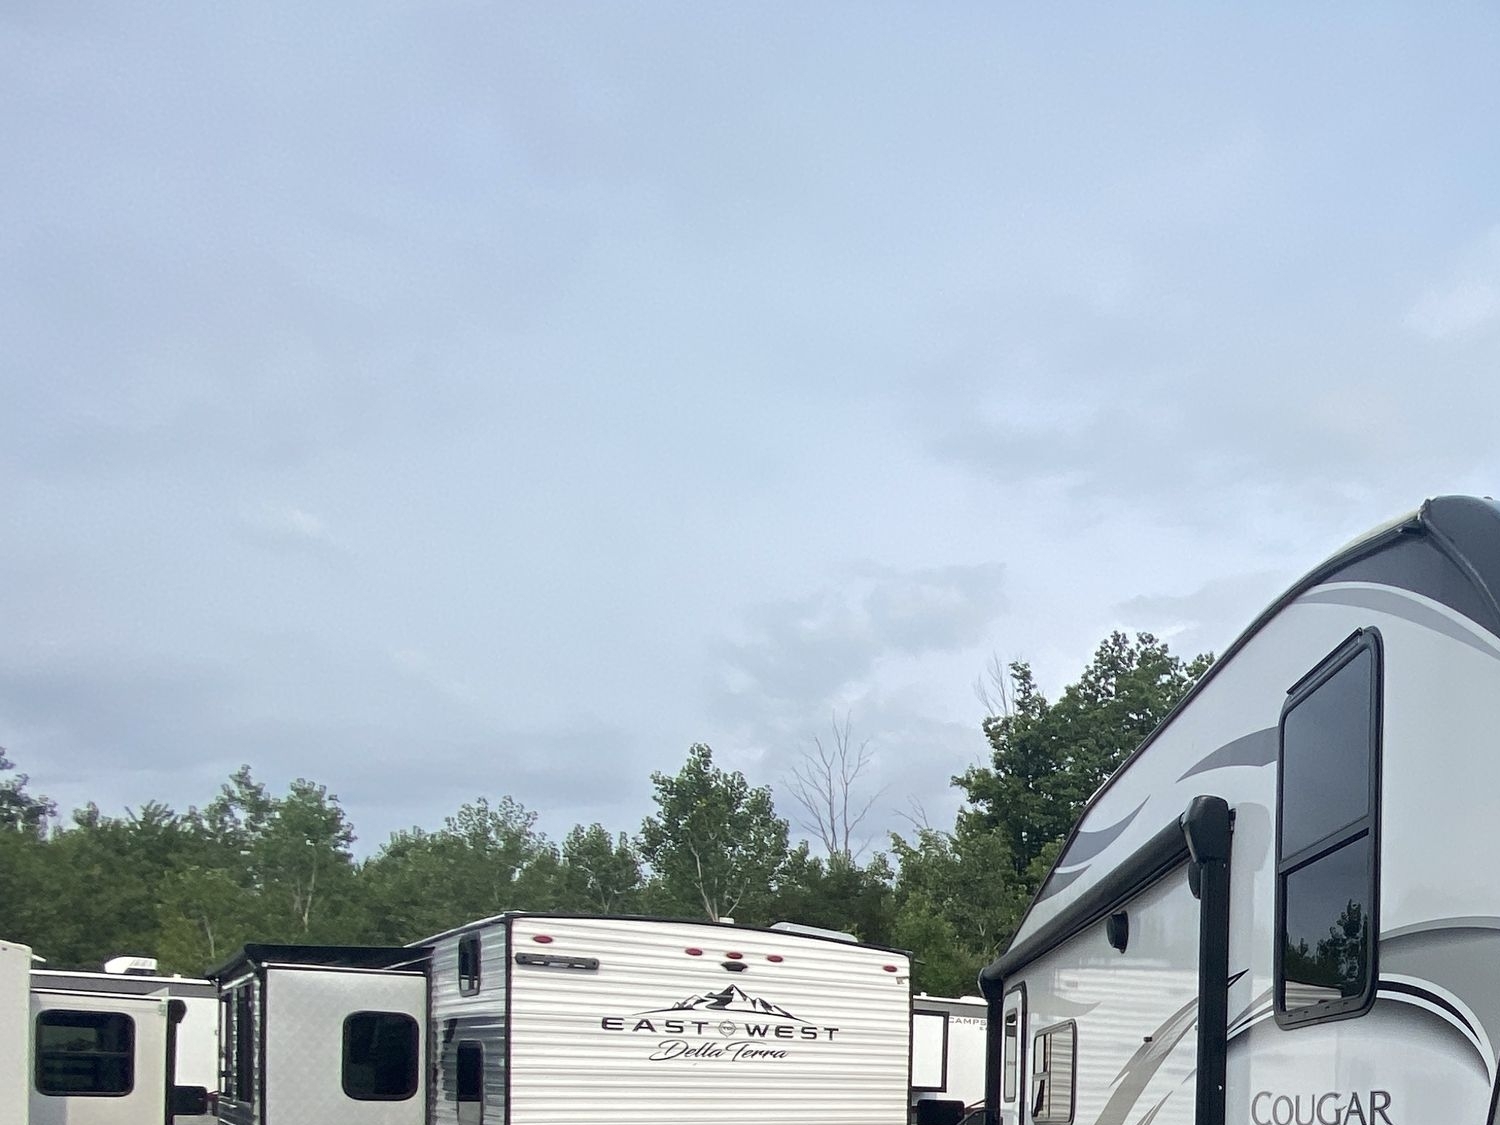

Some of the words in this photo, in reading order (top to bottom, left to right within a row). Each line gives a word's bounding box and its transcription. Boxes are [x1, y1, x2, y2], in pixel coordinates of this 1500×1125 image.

[601, 1016, 709, 1035] EAST
[744, 1023, 840, 1041] WEST
[948, 1016, 987, 1026] CAMPS
[649, 1039, 726, 1062] Della
[725, 1041, 789, 1063] Terra
